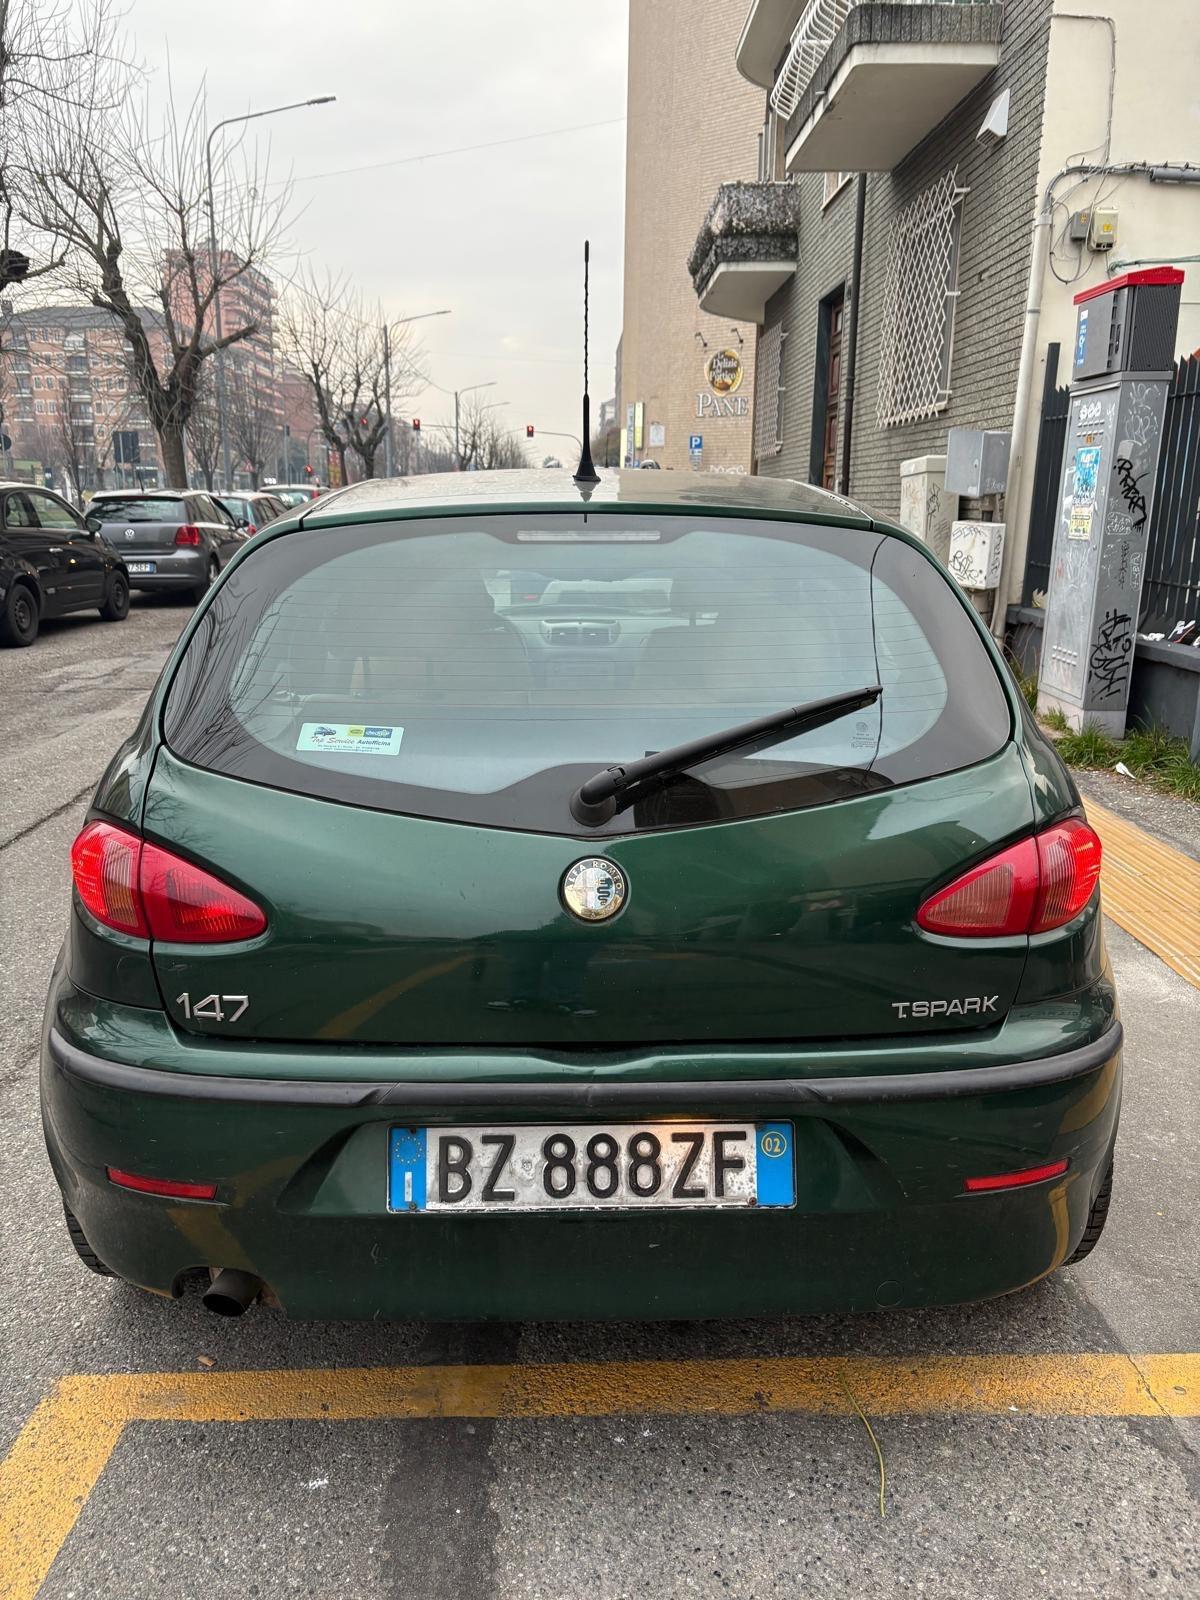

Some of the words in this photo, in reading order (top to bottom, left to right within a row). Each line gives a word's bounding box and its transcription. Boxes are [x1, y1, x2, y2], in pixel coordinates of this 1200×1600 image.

[712, 358, 738, 368] Delizie
[709, 371, 736, 381] Portico
[695, 393, 749, 418] PANE
[691, 437, 701, 448] P
[311, 736, 325, 745] Top
[326, 737, 355, 745] Service
[356, 739, 391, 747] Autofficina
[592, 860, 622, 889] ROMEO
[176, 992, 249, 1022] 147
[765, 1136, 781, 1152] 02
